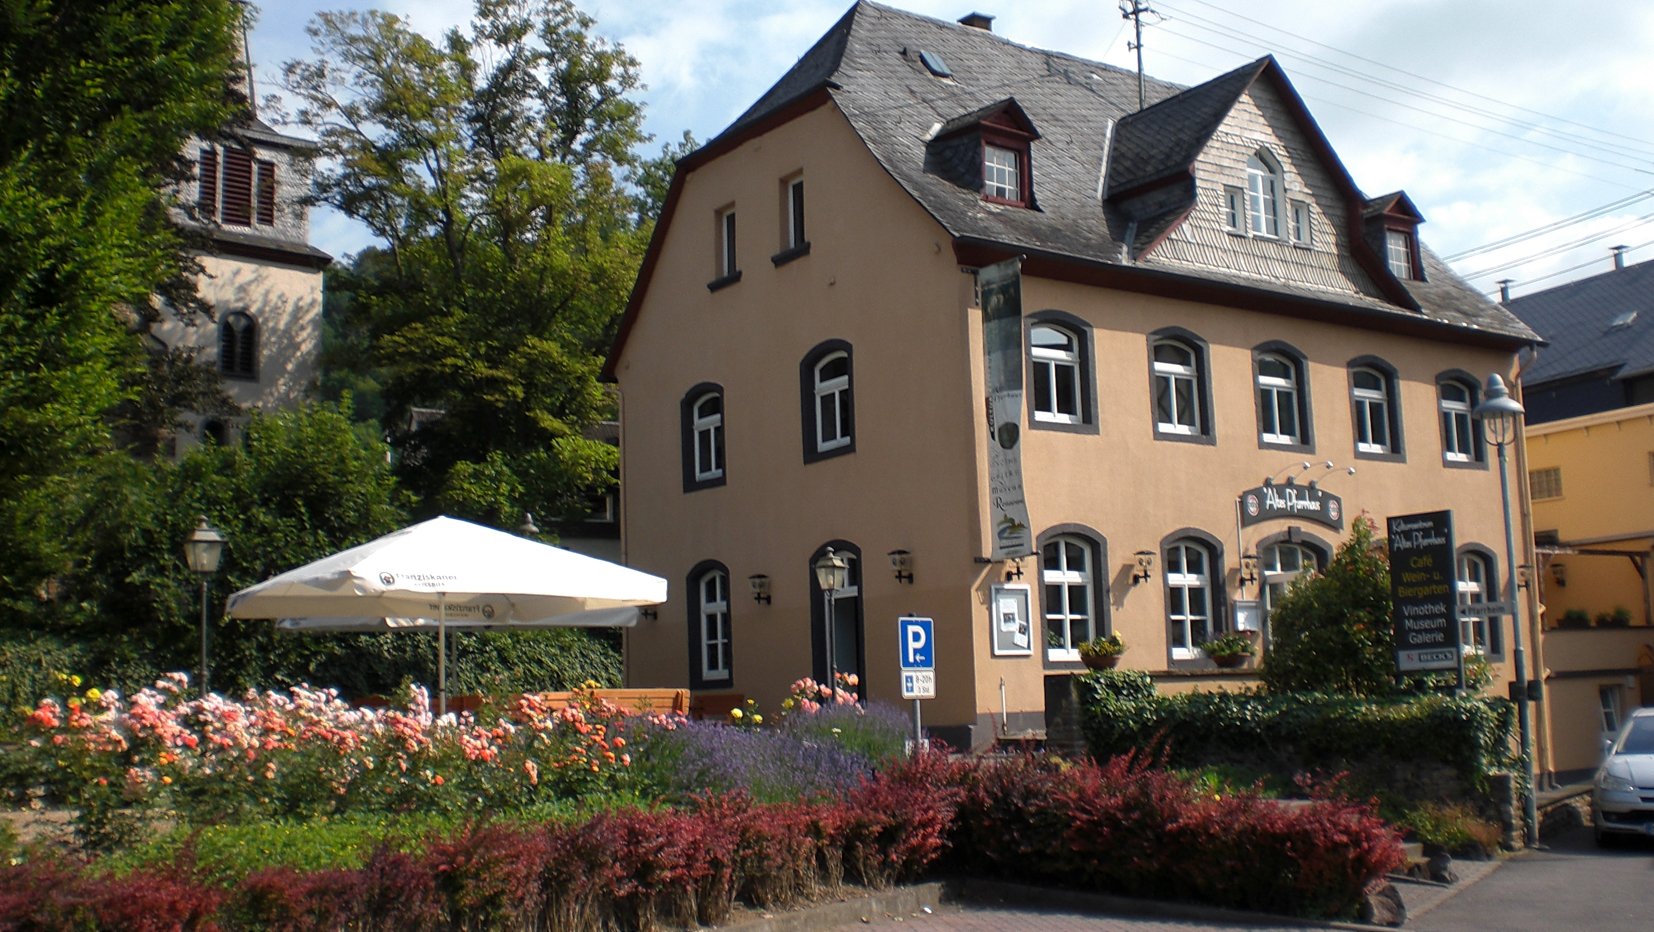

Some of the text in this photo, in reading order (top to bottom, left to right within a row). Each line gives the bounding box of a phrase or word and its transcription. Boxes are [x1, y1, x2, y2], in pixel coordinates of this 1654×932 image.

[1409, 553, 1433, 568] Café
[1401, 571, 1431, 583] Wein-
[1398, 583, 1450, 598] Biergarten
[1403, 602, 1447, 616] Vinothek
[1405, 617, 1447, 631] Museum
[906, 624, 927, 664] P
[1409, 632, 1445, 645] Galerie
